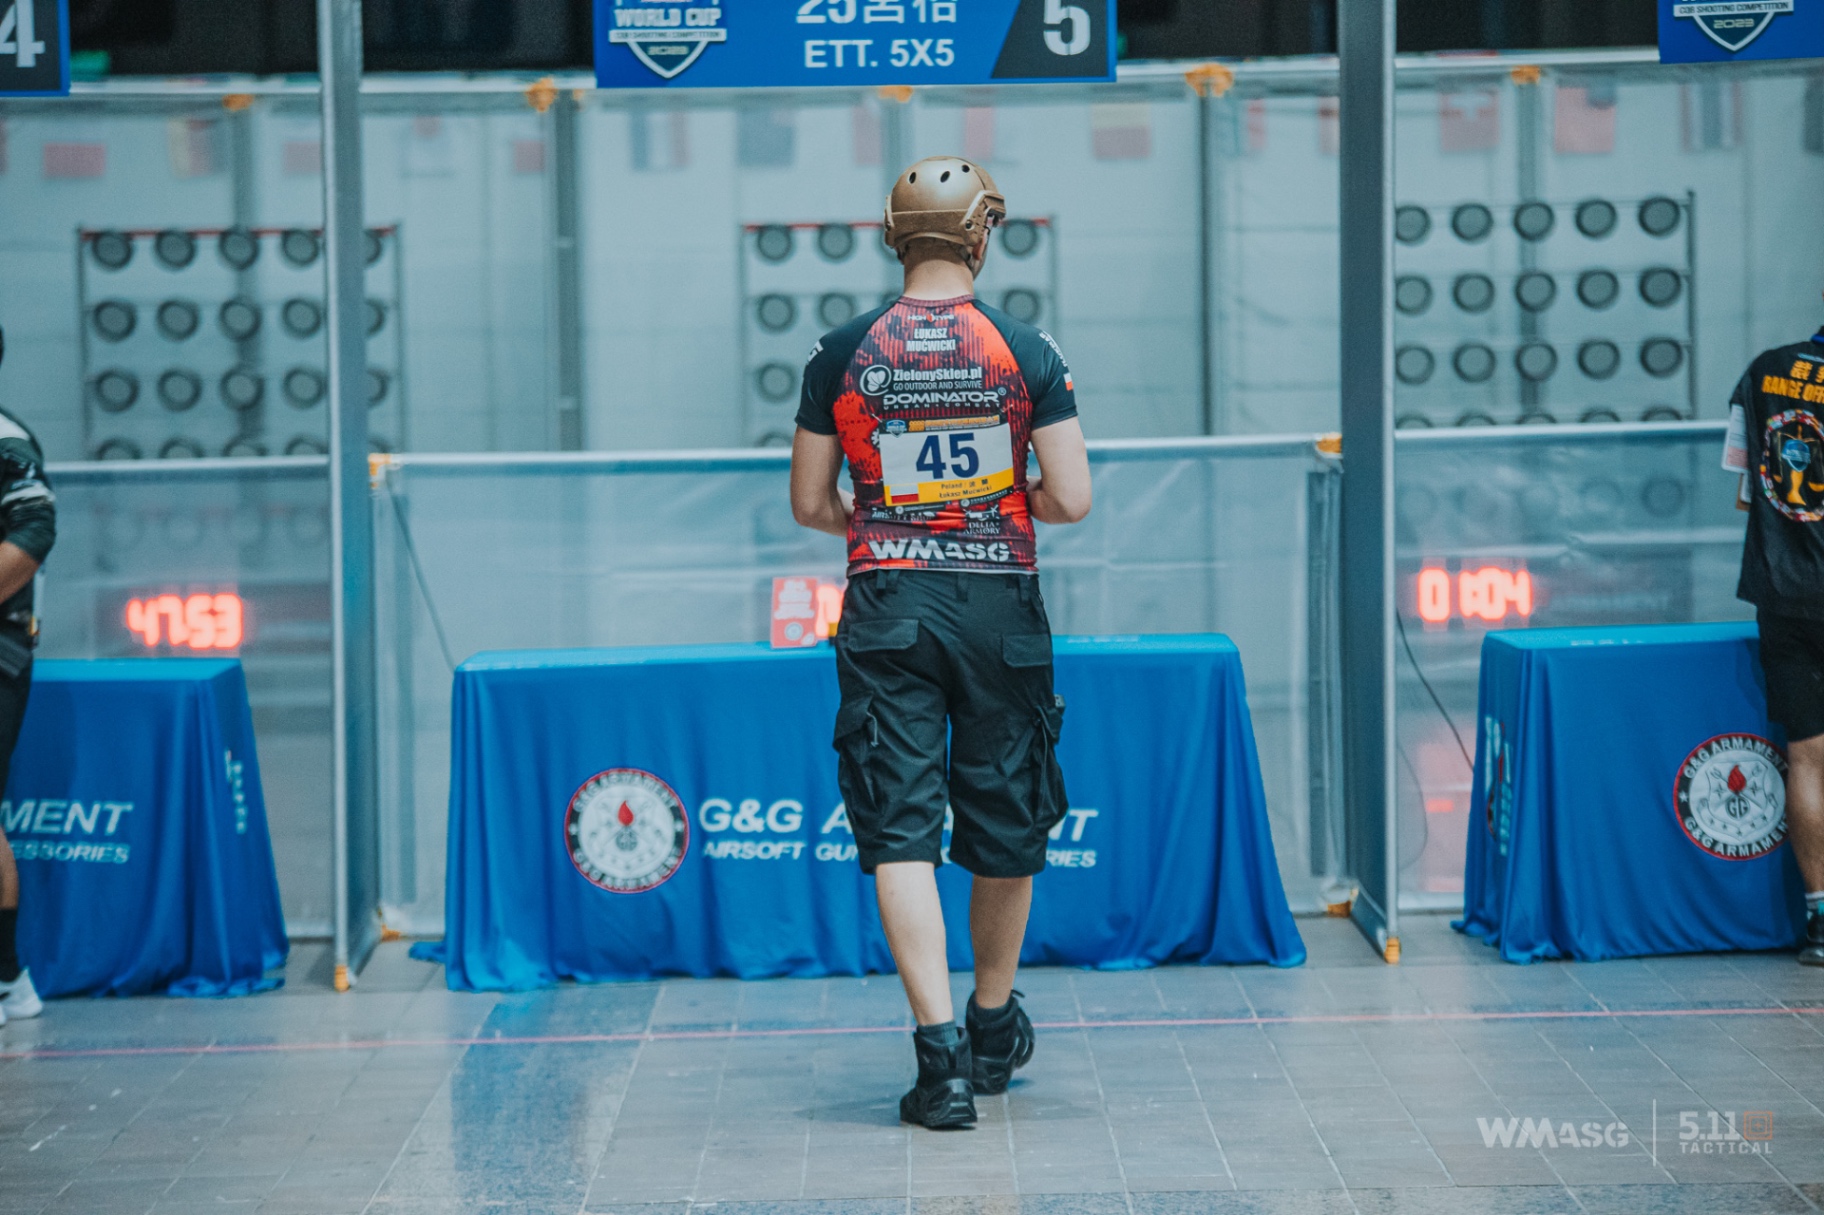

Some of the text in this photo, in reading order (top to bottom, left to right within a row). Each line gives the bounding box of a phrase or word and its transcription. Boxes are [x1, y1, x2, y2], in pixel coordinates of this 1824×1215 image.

[614, 8, 721, 27] WORLD CUP
[1043, 0, 1091, 55] 5
[1713, 18, 1755, 29] 2023
[0, 0, 45, 67] 4
[804, 38, 955, 68] ETT. 5X5
[914, 328, 948, 339] ŁUKASZ
[906, 339, 956, 352] MUĆWICKI
[893, 367, 982, 381] ZielonySklep.pl
[904, 382, 938, 391] OUTDOOR
[938, 381, 954, 390] AND
[954, 380, 982, 389] SURVIVE
[1762, 375, 1804, 399] RANGE
[916, 432, 979, 479] 45
[868, 539, 1010, 561] WMASG
[1684, 748, 1710, 778] G&G
[699, 799, 803, 833] G&G
[1714, 820, 1787, 857] ARMAMEN
[704, 841, 806, 860] AIRSOFT
